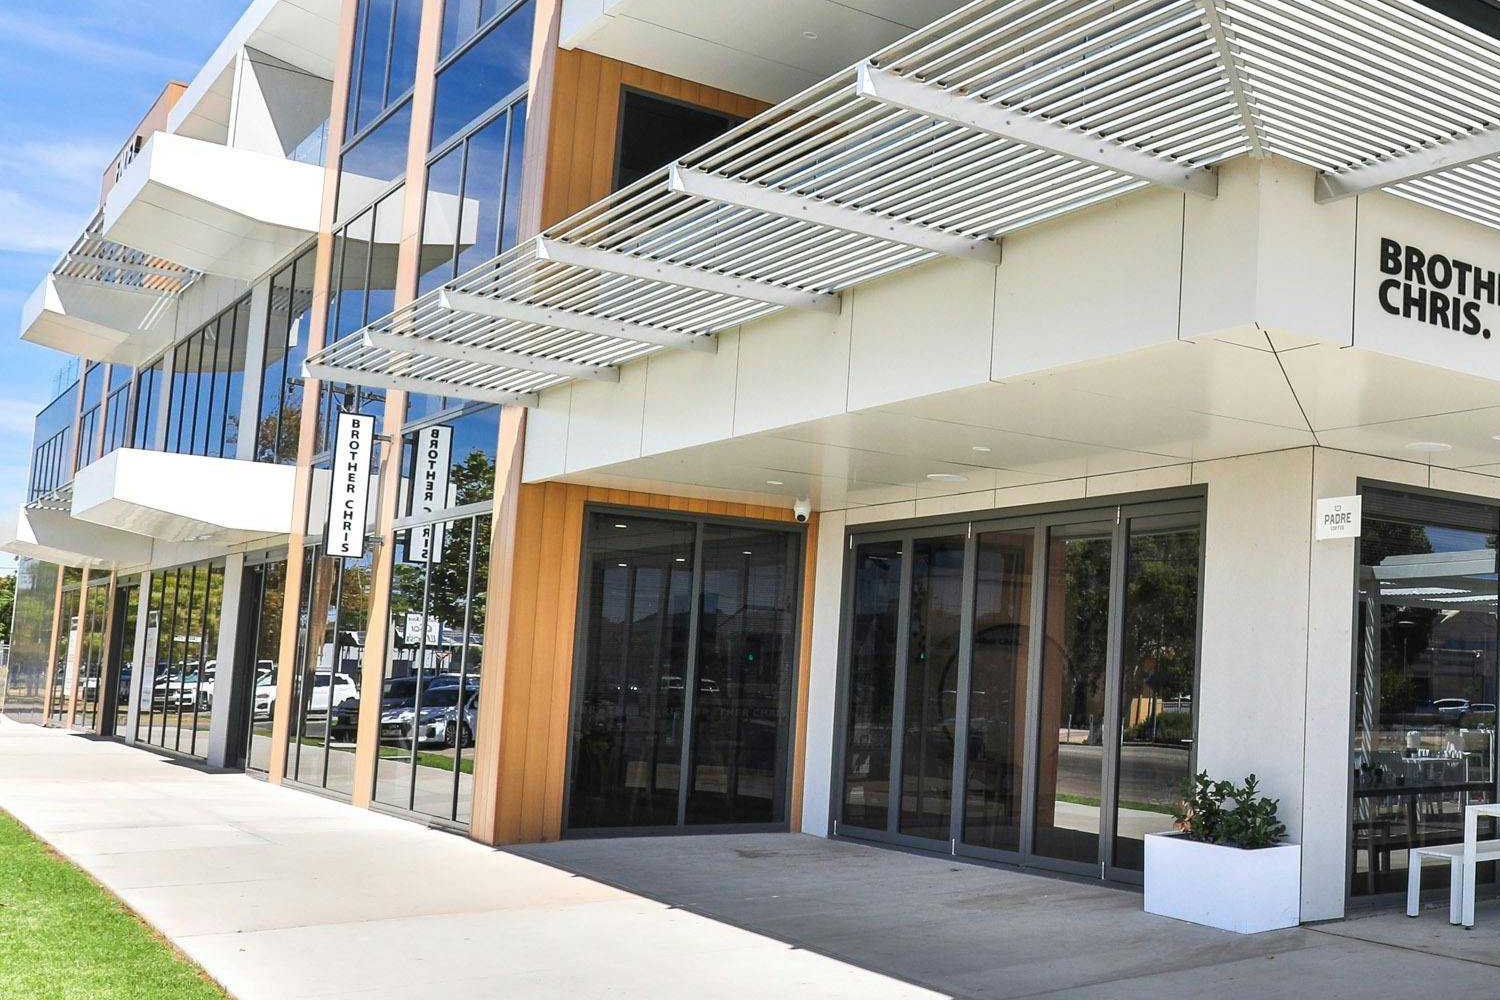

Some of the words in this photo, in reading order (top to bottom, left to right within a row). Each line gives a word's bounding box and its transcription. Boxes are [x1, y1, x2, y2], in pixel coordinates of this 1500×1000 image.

[1378, 278, 1491, 340] CHRIS.
[347, 419, 360, 494] BROTHER
[341, 499, 353, 553] CHRIS
[1324, 512, 1352, 525] PADRE
